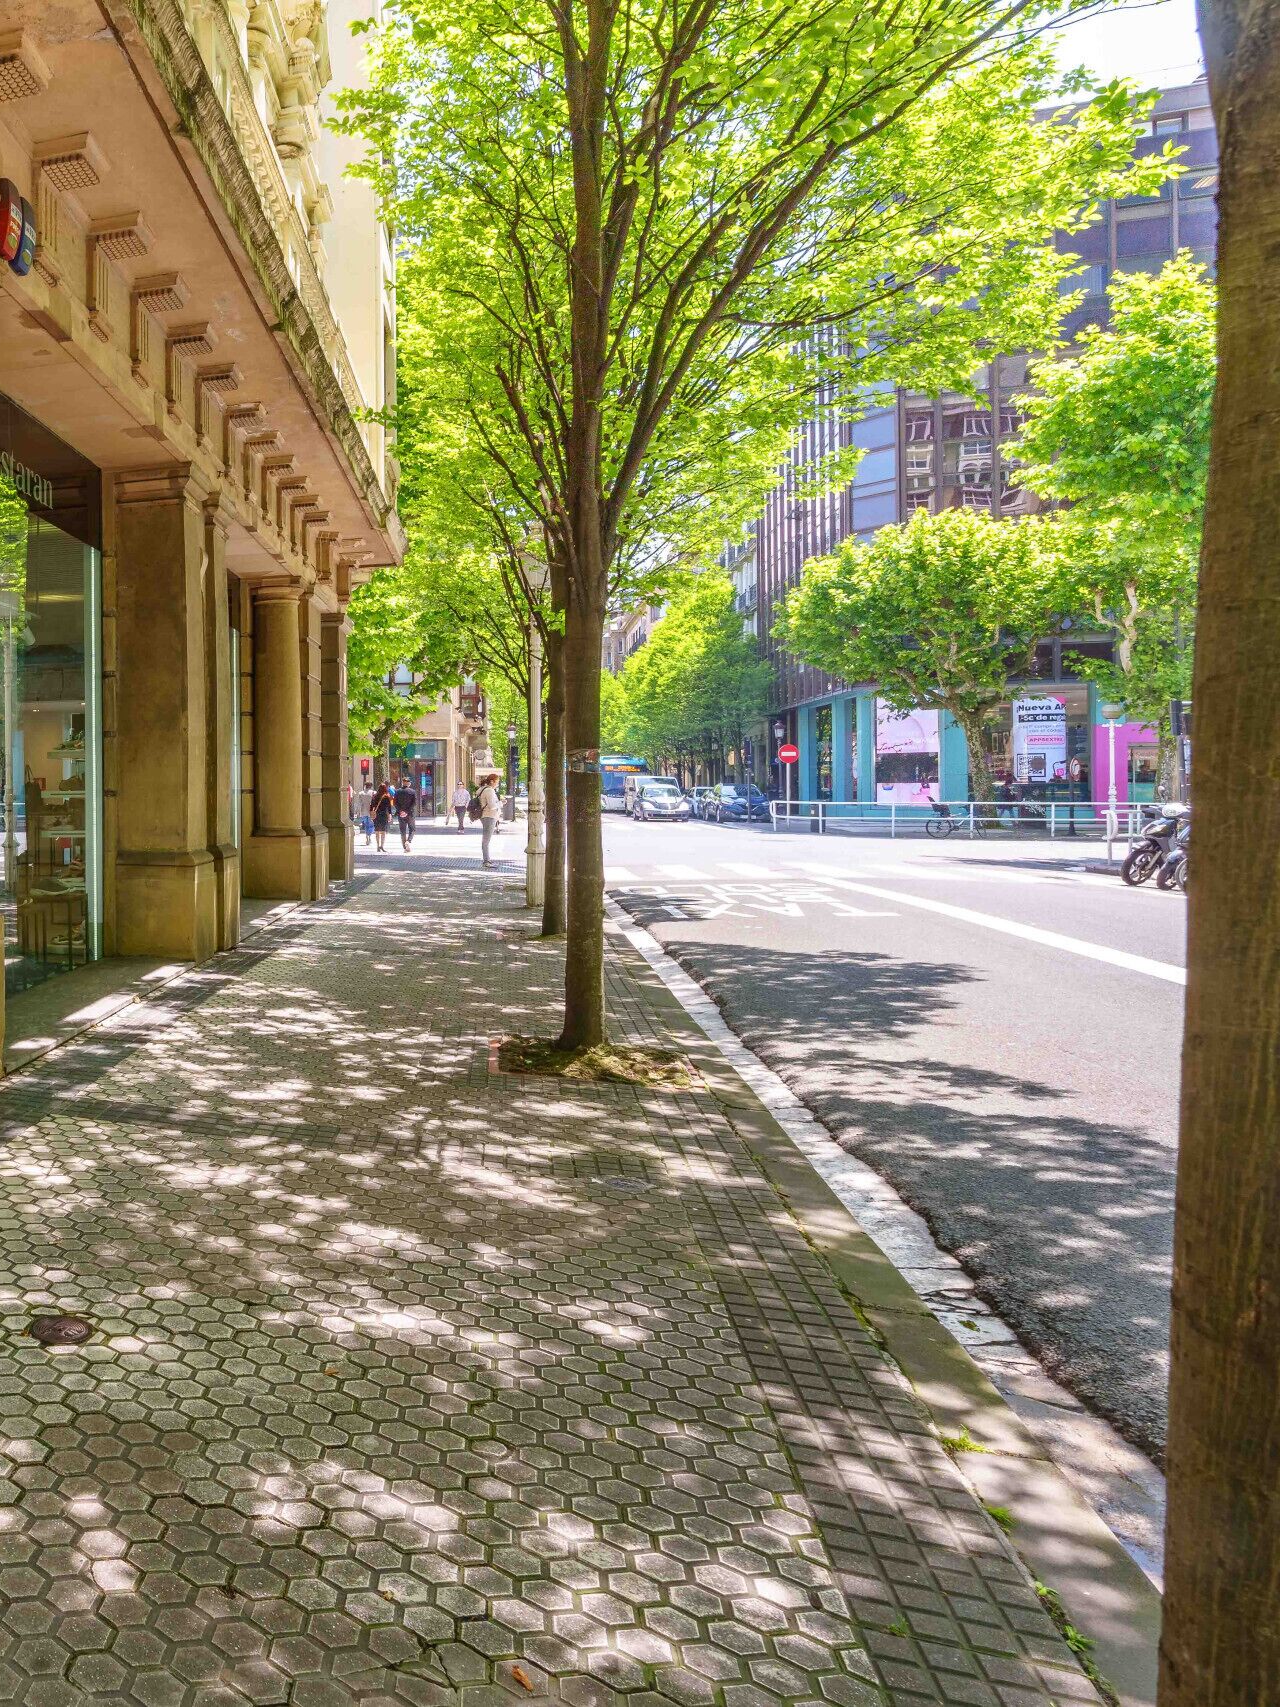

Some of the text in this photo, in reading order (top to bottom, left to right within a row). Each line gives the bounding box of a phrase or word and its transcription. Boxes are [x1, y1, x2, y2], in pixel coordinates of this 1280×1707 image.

[618, 883, 835, 895] SOLO
[656, 892, 841, 903] BUS
[661, 902, 901, 918] TAXI
